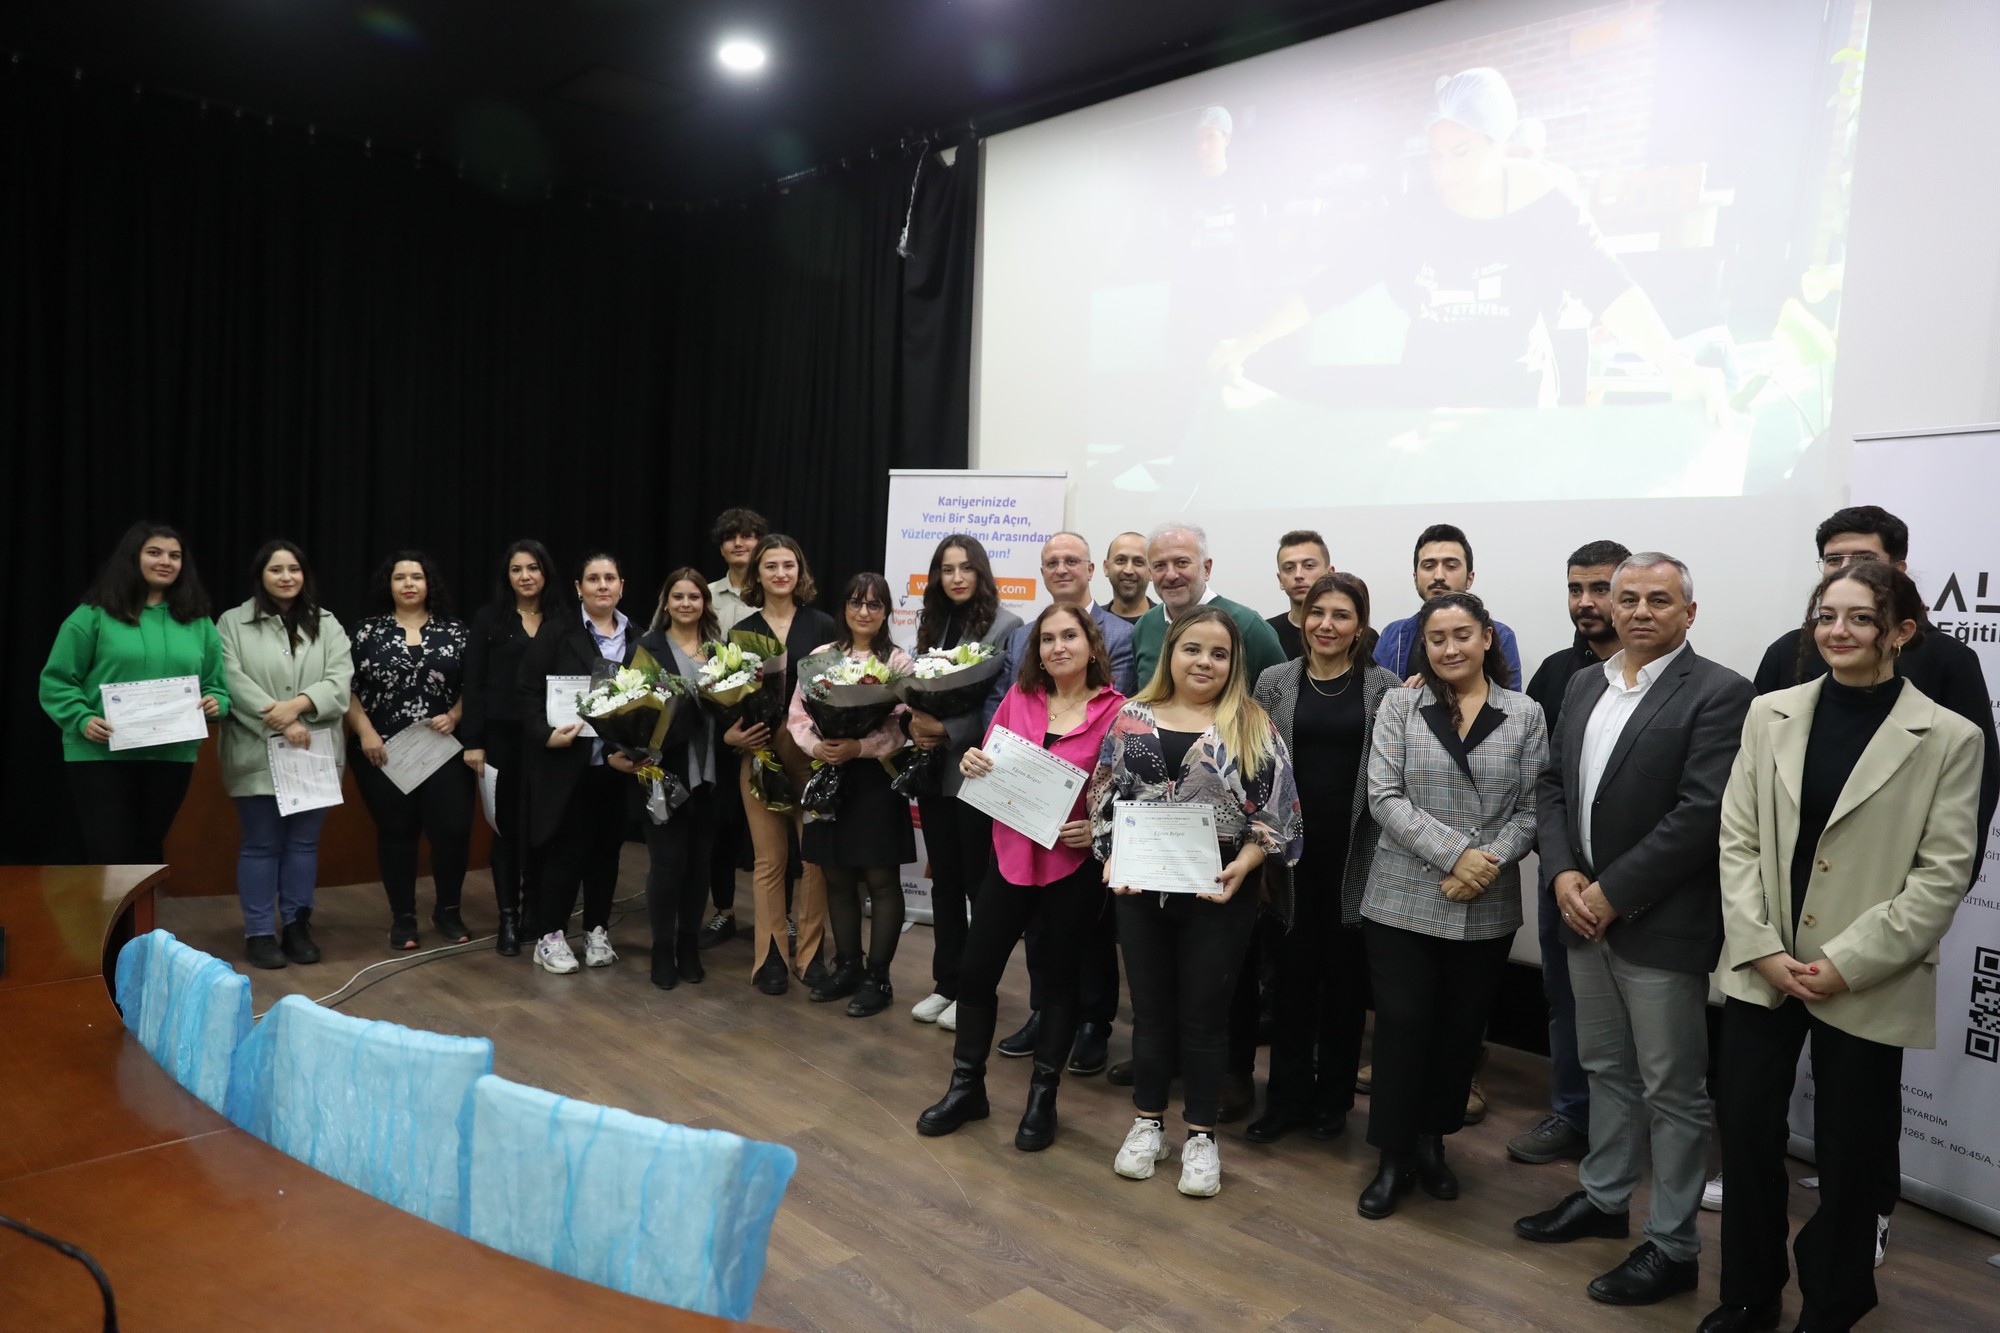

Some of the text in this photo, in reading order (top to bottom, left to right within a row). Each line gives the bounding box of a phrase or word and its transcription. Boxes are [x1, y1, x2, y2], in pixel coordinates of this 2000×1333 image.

[938, 495, 1017, 509] Kariyerinizde
[922, 512, 1032, 527] Yeni Bir Sayfa Açın,
[901, 528, 949, 540] Yüzlerce
[988, 548, 1011, 560] pın!
[998, 584, 1027, 594] .com
[1936, 621, 2000, 645] Eğiti
[1903, 1127, 1928, 1142] 1265.
[1930, 1136, 1947, 1149] SK.
